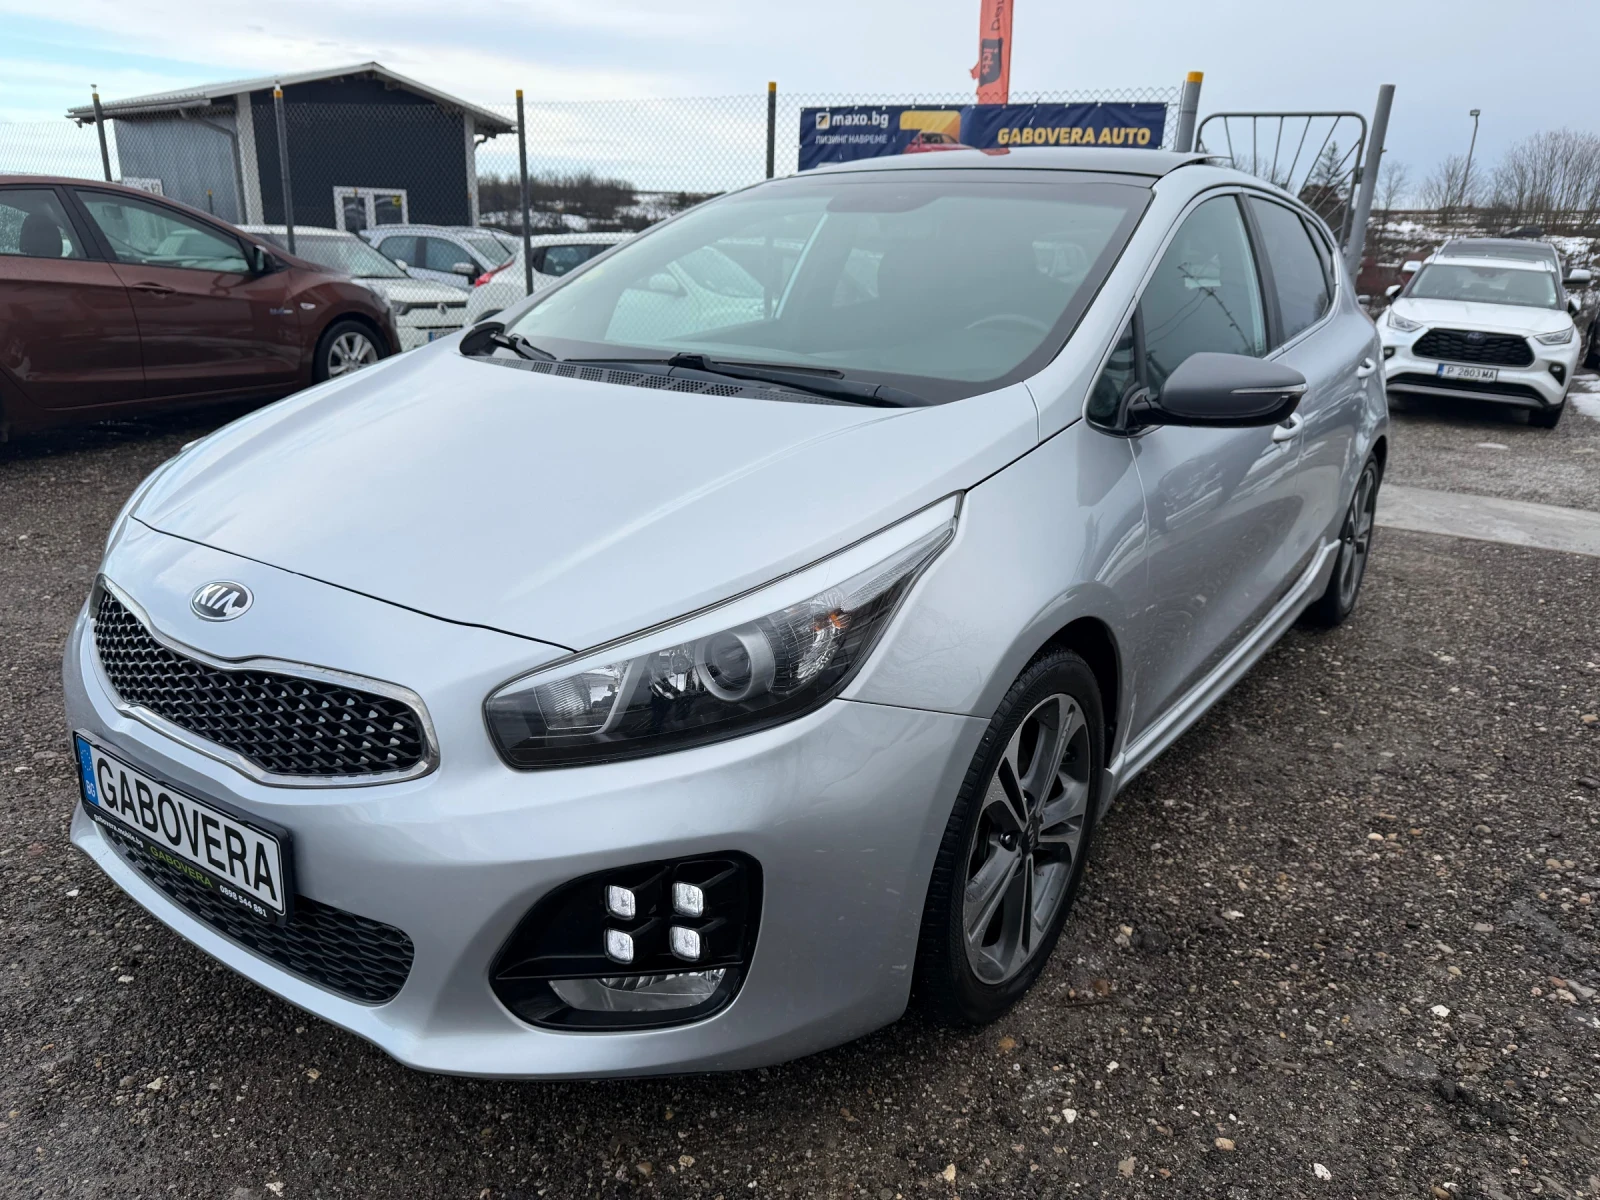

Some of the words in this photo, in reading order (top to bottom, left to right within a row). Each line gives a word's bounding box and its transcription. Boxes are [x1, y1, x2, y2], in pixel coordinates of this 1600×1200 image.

[832, 110, 889, 128] maxo.bg
[997, 127, 1095, 145] GABOVERA
[1098, 127, 1151, 145] AUTO
[1447, 365, 1454, 374] P
[1482, 369, 1494, 379] MA
[194, 583, 240, 613] KIA
[85, 780, 96, 797] BG
[97, 757, 278, 902] GABOVERA
[149, 846, 213, 889] GABOVERA
[219, 884, 238, 901] 0898
[239, 895, 253, 909] 544
[253, 902, 268, 917] 881
